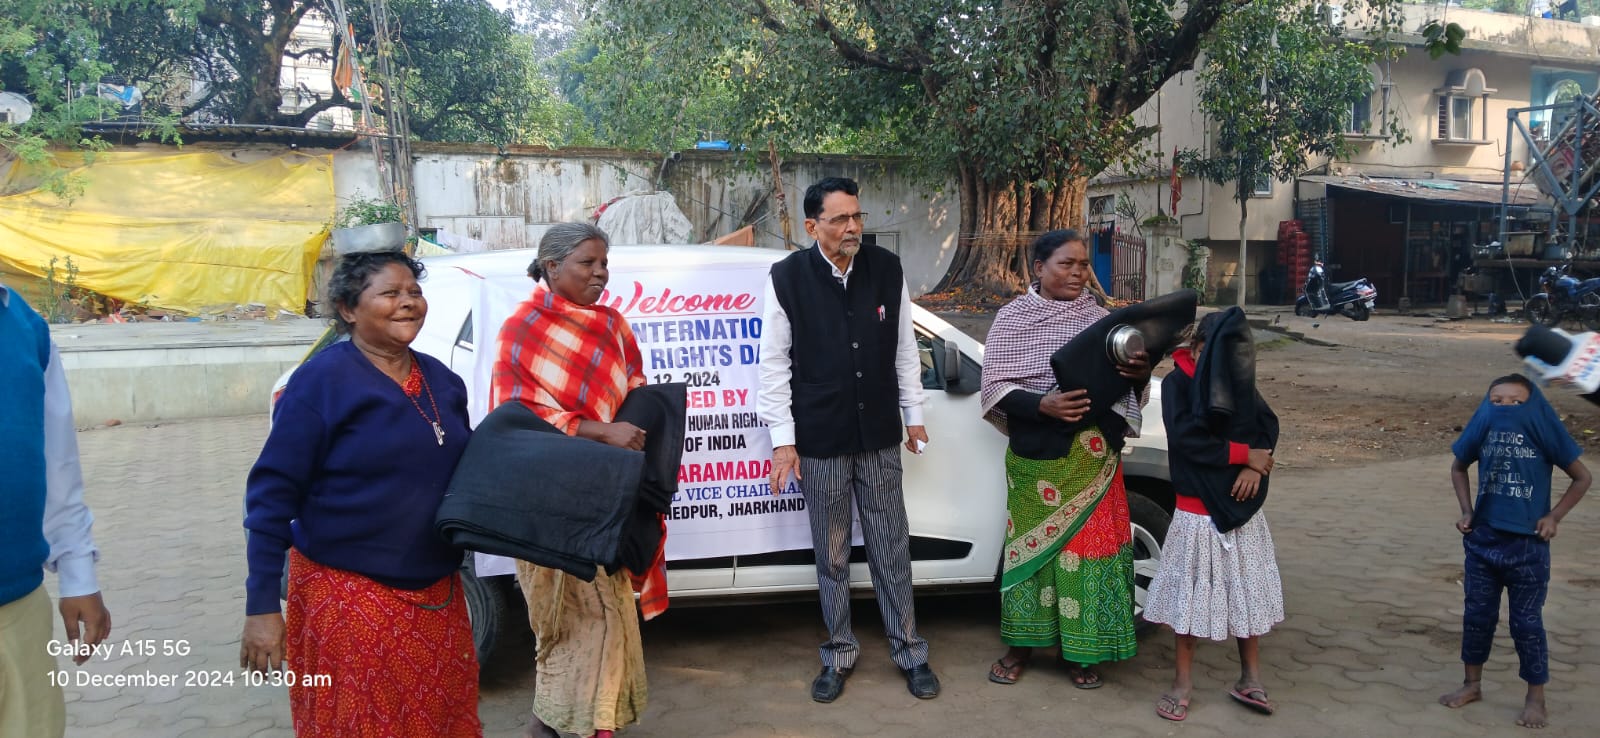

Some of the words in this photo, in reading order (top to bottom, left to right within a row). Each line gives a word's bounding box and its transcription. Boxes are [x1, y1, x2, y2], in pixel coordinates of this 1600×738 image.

[597, 281, 756, 314] Welcome
[651, 344, 733, 370] RIGHTS
[740, 343, 761, 365] D
[684, 371, 721, 387] 2024
[723, 388, 749, 407] BY
[688, 412, 729, 432] HUMAN
[732, 411, 769, 430] RIGH
[685, 436, 703, 452] OF
[708, 434, 747, 450] INDIA
[685, 487, 722, 501] VICE
[728, 497, 806, 517] JHARKHAND
